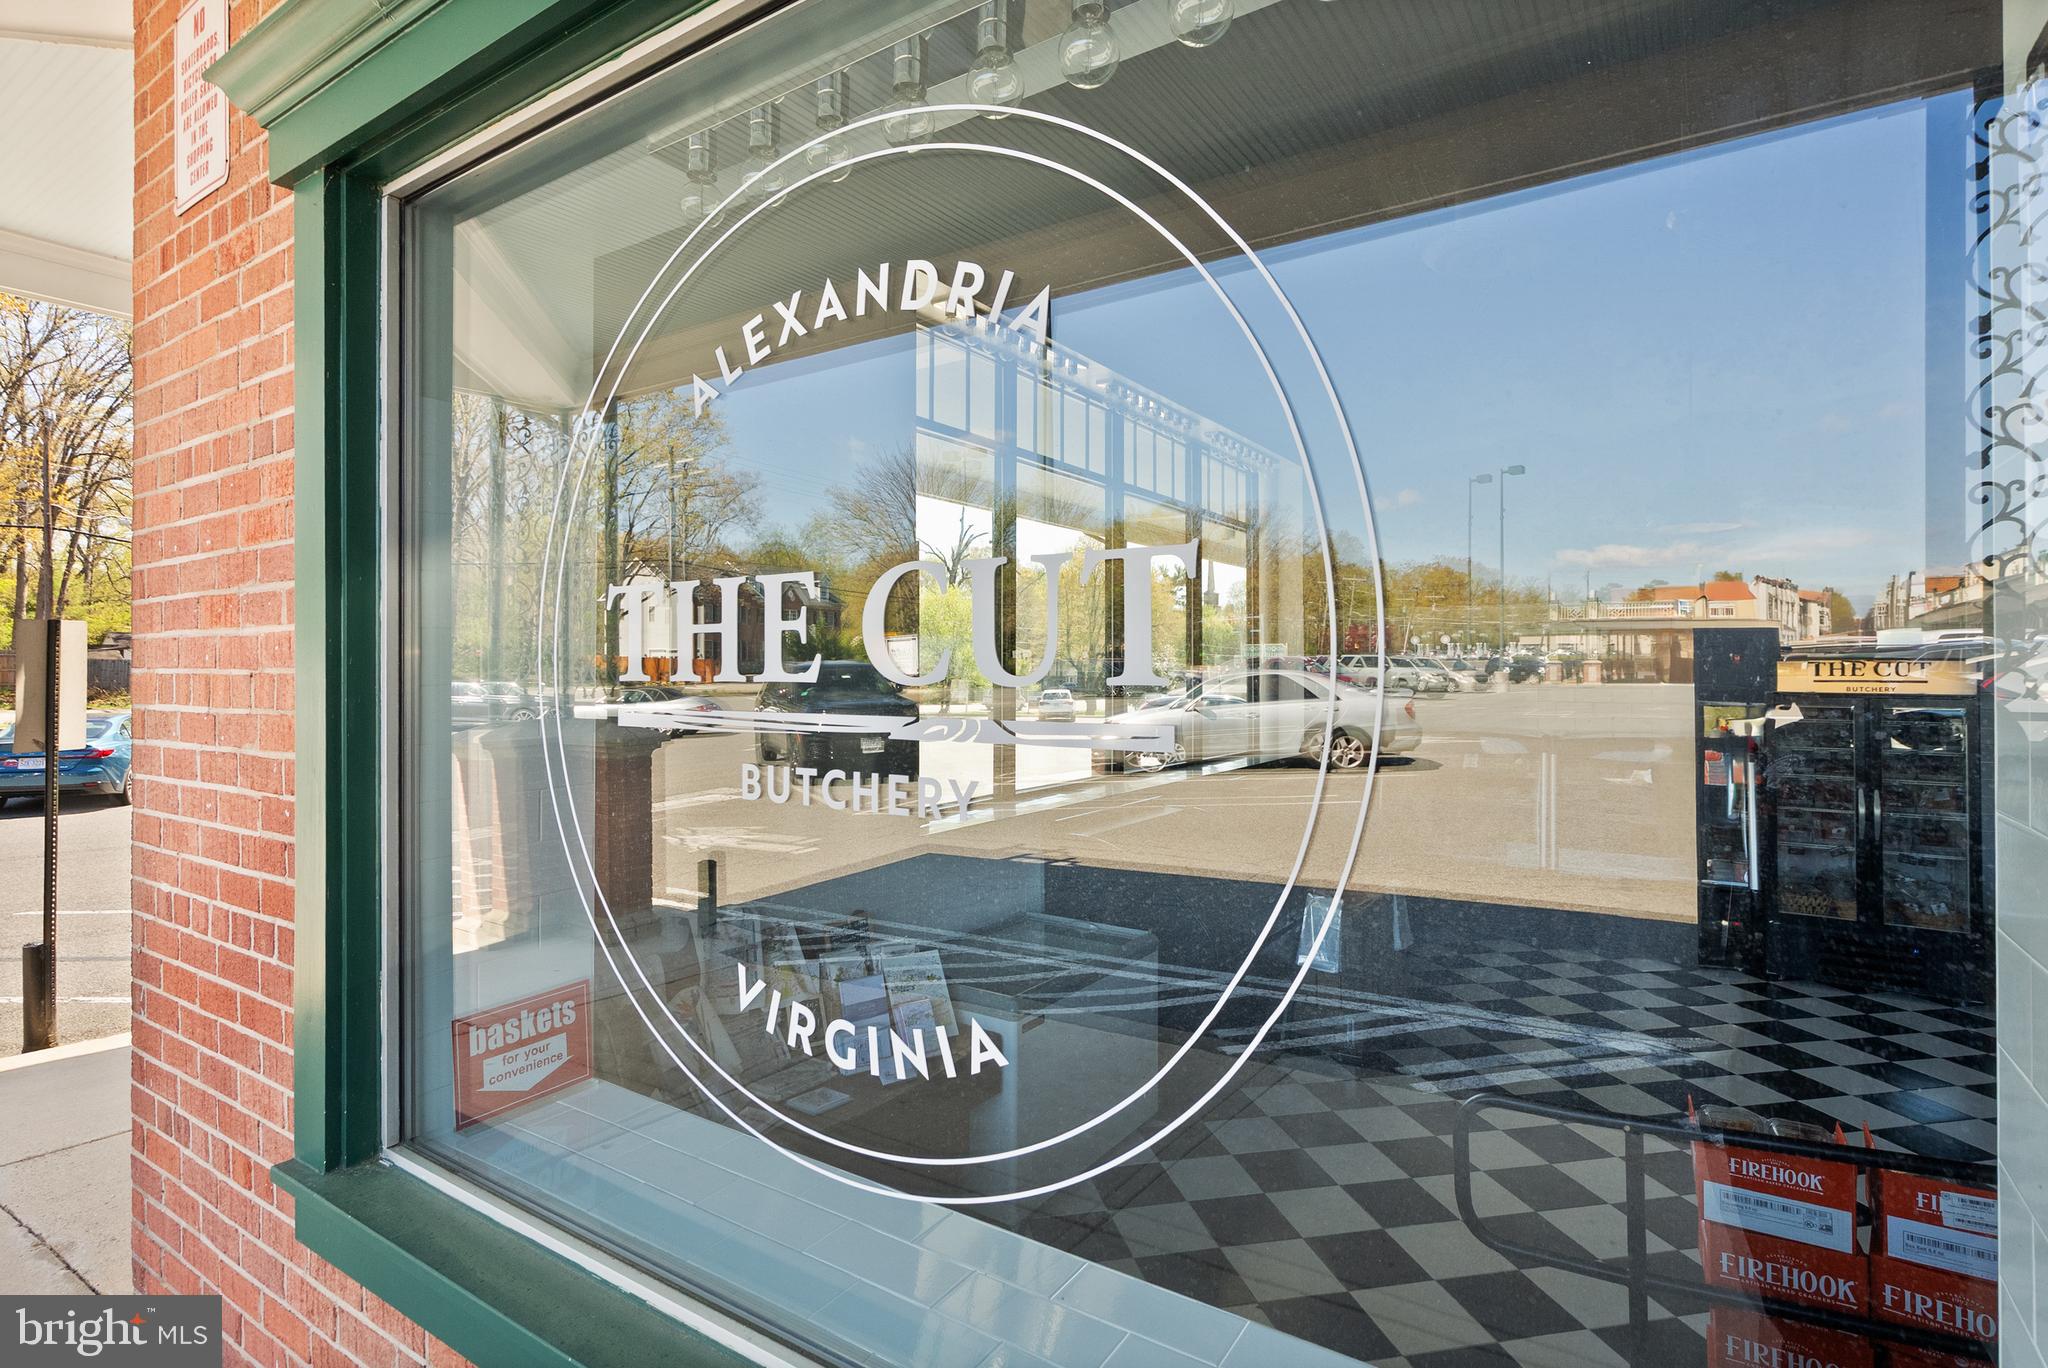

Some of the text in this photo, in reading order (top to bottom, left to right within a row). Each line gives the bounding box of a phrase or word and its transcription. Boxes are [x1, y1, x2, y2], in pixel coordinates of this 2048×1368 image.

[193, 6, 205, 39] NO
[181, 88, 198, 115] ROLLER
[183, 92, 218, 134] ARE ALLOWED
[191, 120, 209, 146] IN THE
[186, 137, 213, 169] SHOPPING
[189, 160, 209, 187] CENTER
[693, 259, 1050, 420] ALEXANDRIA
[606, 538, 1199, 688] THE CUT
[1807, 661, 1932, 678] THE CUT
[741, 763, 979, 821] BUTCHERY
[469, 1000, 577, 1057] baskets
[737, 962, 1009, 1080] VIRGINIA
[488, 1051, 564, 1086] convenience
[502, 1042, 552, 1066] for your
[1728, 1157, 1824, 1191] FIREHOOK
[1719, 1252, 1858, 1303] FIREHOOK
[1882, 1283, 1997, 1338] FIREHO
